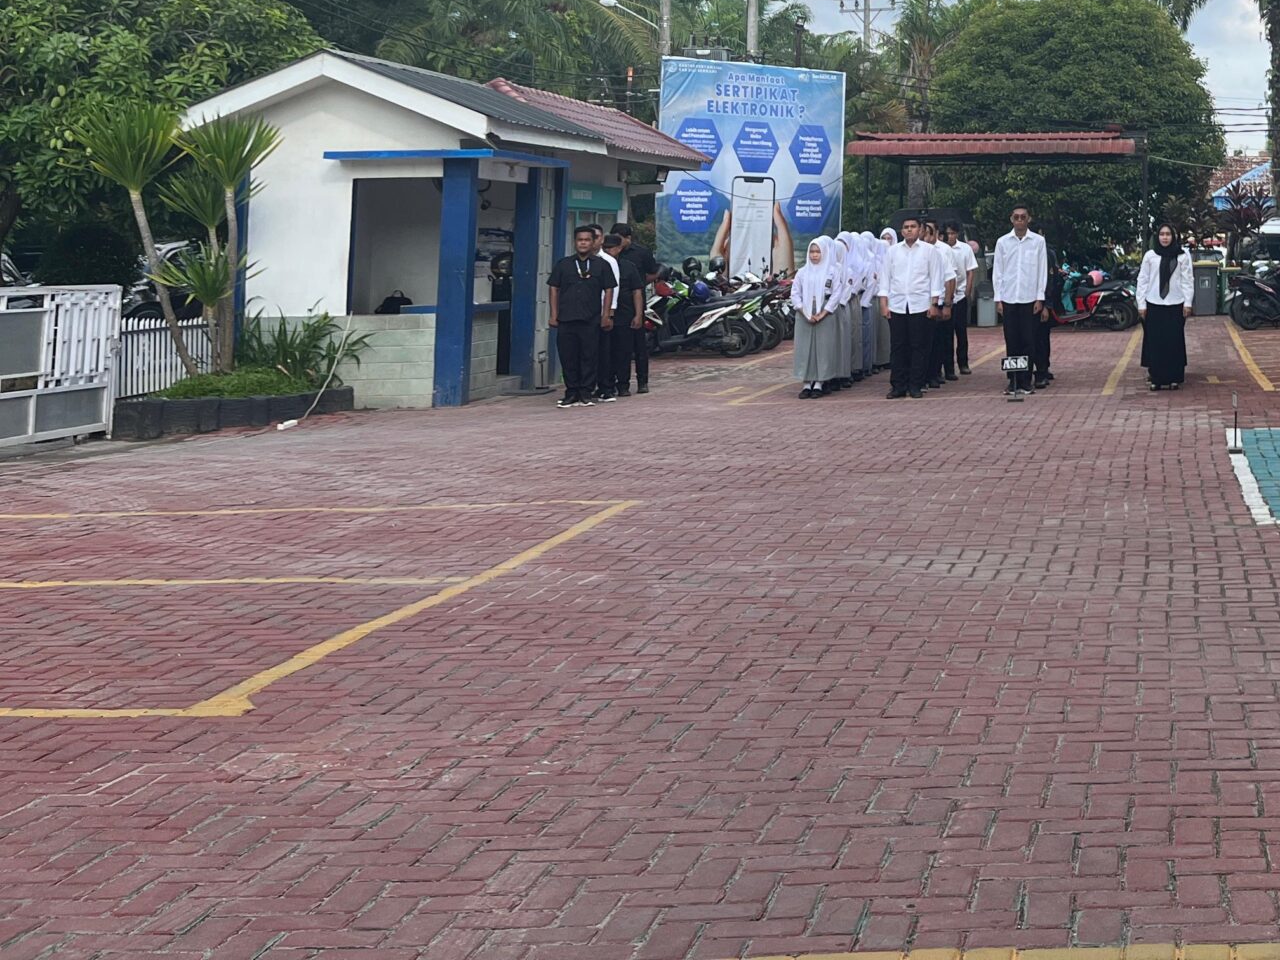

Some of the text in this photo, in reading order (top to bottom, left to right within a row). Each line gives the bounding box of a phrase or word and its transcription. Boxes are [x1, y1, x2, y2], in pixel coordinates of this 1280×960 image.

[728, 72, 746, 82] Apa
[716, 84, 798, 102] SERTIPIKAT
[707, 100, 794, 117] ELEKTRONIK
